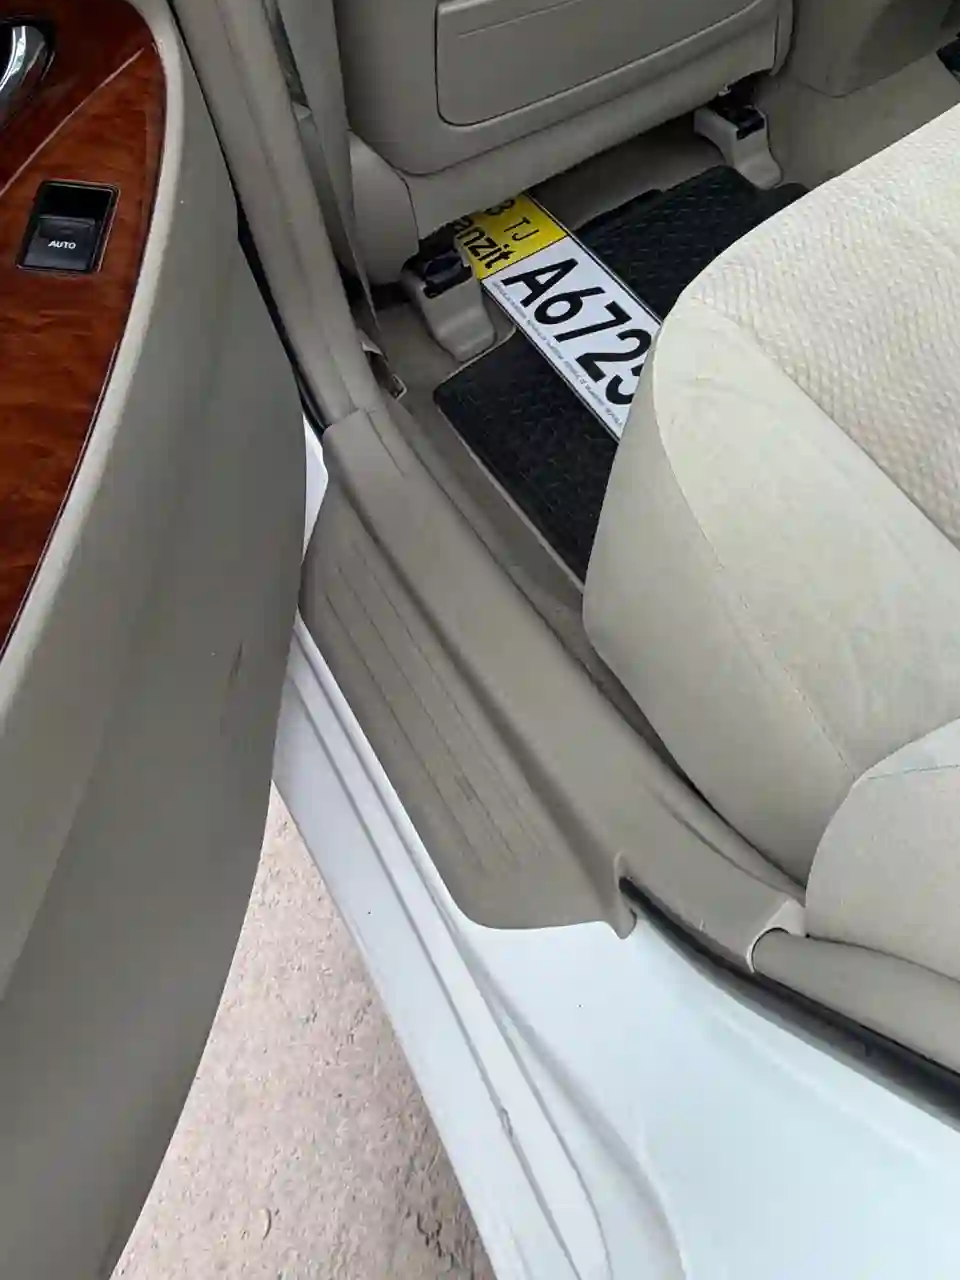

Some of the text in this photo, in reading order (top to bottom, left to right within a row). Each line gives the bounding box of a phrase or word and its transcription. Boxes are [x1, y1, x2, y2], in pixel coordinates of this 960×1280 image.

[503, 216, 540, 242] TJ
[48, 240, 76, 249] AUTO
[453, 216, 516, 269] anzit
